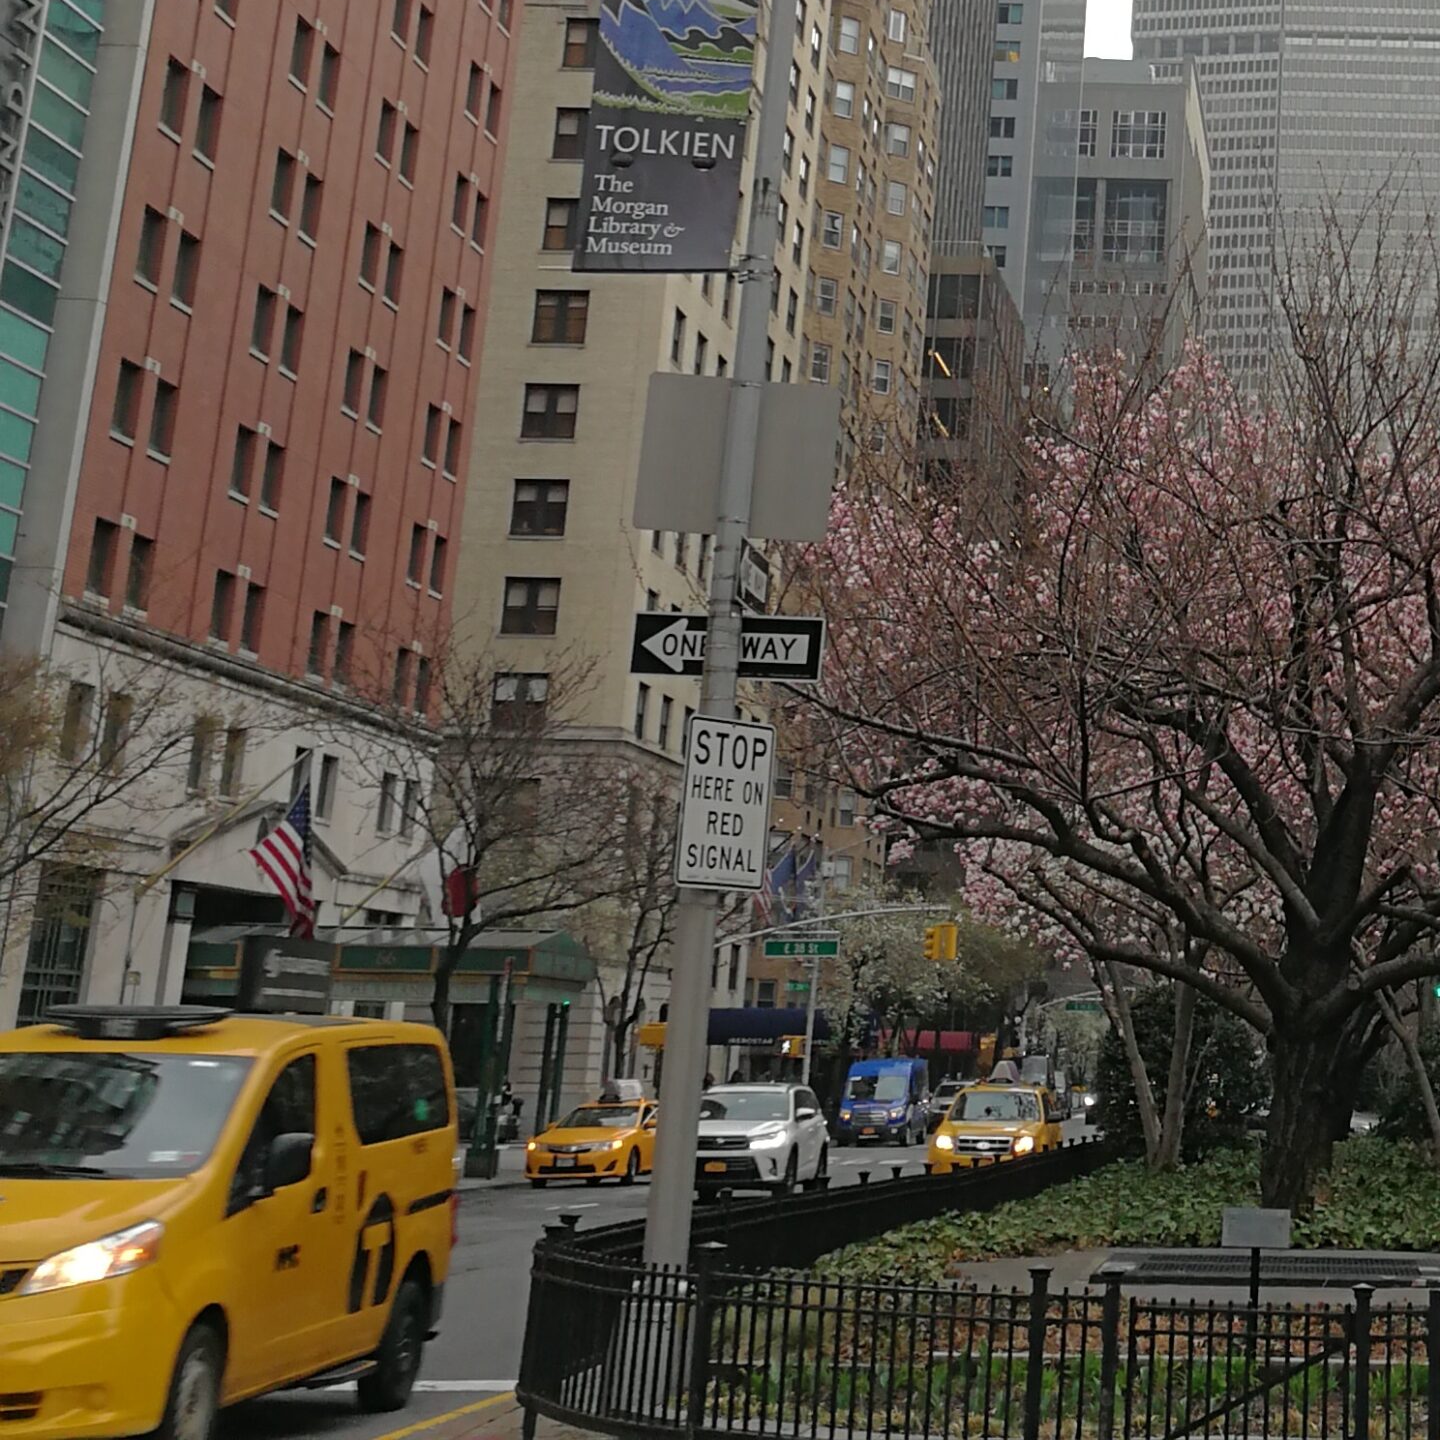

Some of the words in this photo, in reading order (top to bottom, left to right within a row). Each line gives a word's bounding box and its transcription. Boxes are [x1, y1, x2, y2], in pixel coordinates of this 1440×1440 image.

[595, 125, 735, 159] TOLKIEN
[594, 174, 634, 193] The
[592, 196, 669, 219] Morgan
[588, 216, 661, 240] Library
[663, 223, 685, 238] &
[585, 236, 672, 255] Museum
[742, 637, 797, 660] WAY
[694, 730, 767, 771] STOP
[691, 774, 734, 802] HERE
[743, 781, 764, 805] ON
[706, 811, 744, 837] RED
[686, 844, 757, 872] SIGNAL
[784, 943, 790, 954] E
